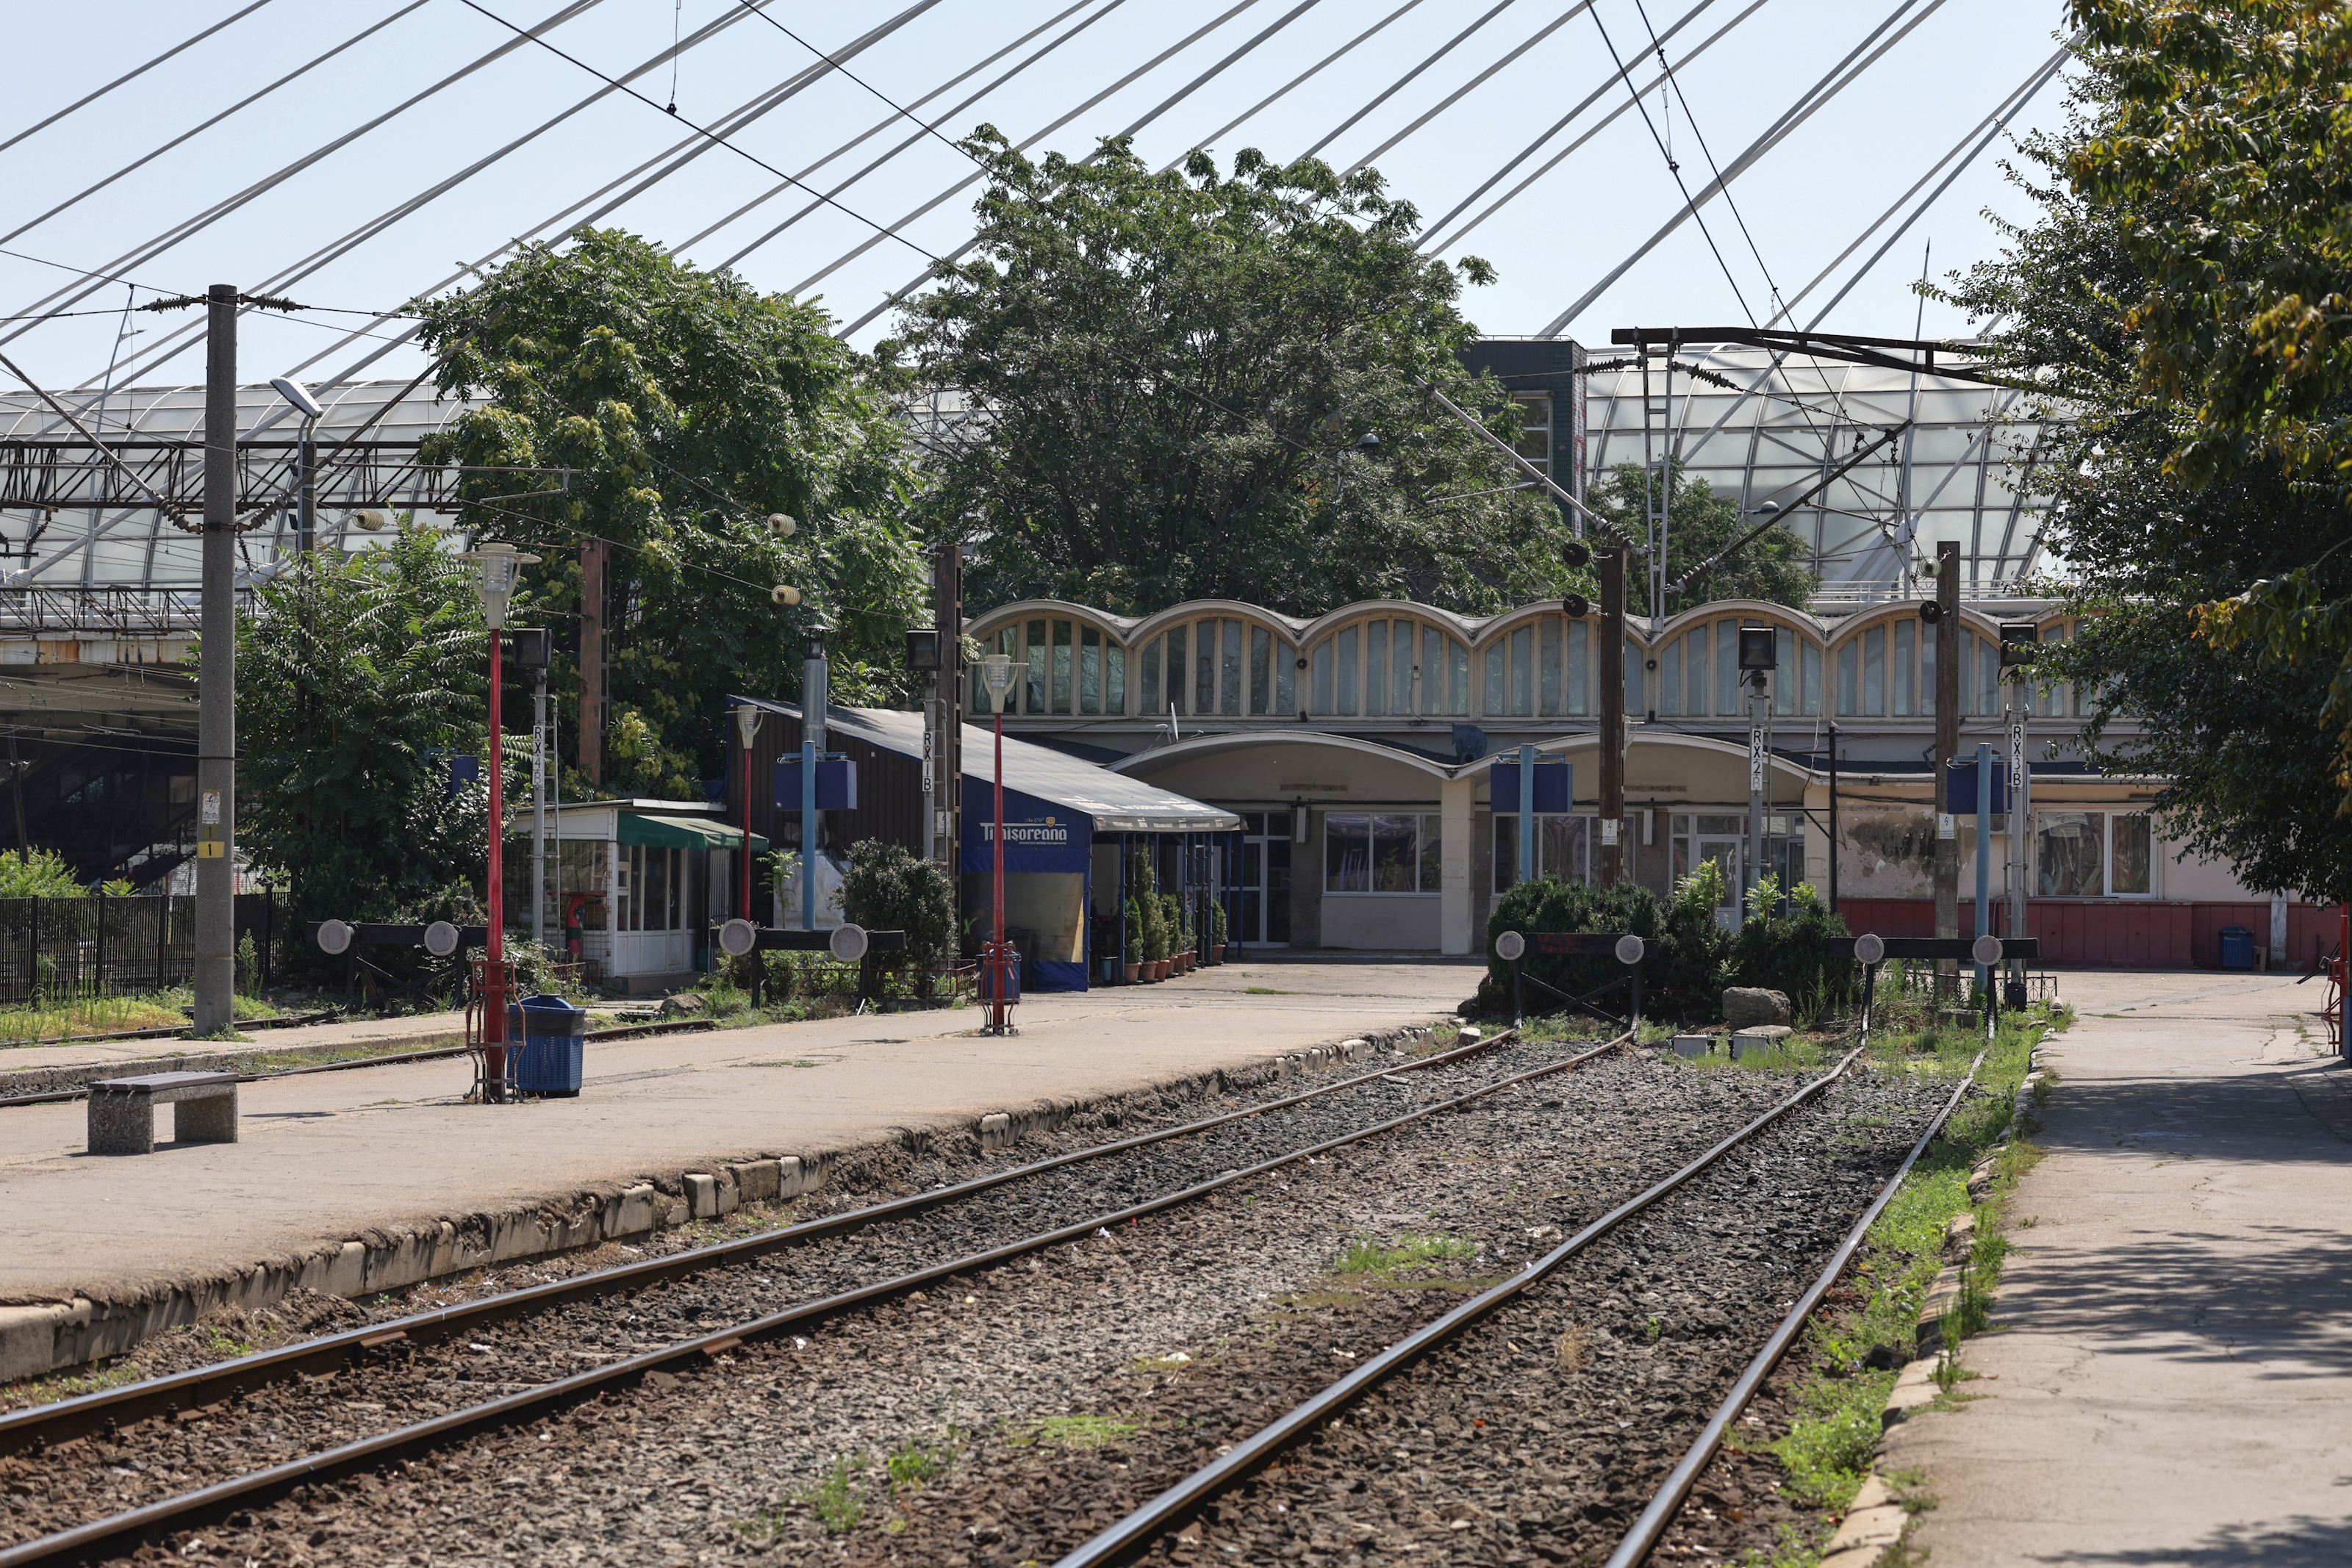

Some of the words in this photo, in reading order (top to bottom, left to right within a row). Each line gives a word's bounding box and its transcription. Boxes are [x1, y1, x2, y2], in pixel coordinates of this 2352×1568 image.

[1752, 730, 1761, 789] RX2B
[2013, 726, 2021, 785] RX3B
[207, 844, 212, 856] 1
